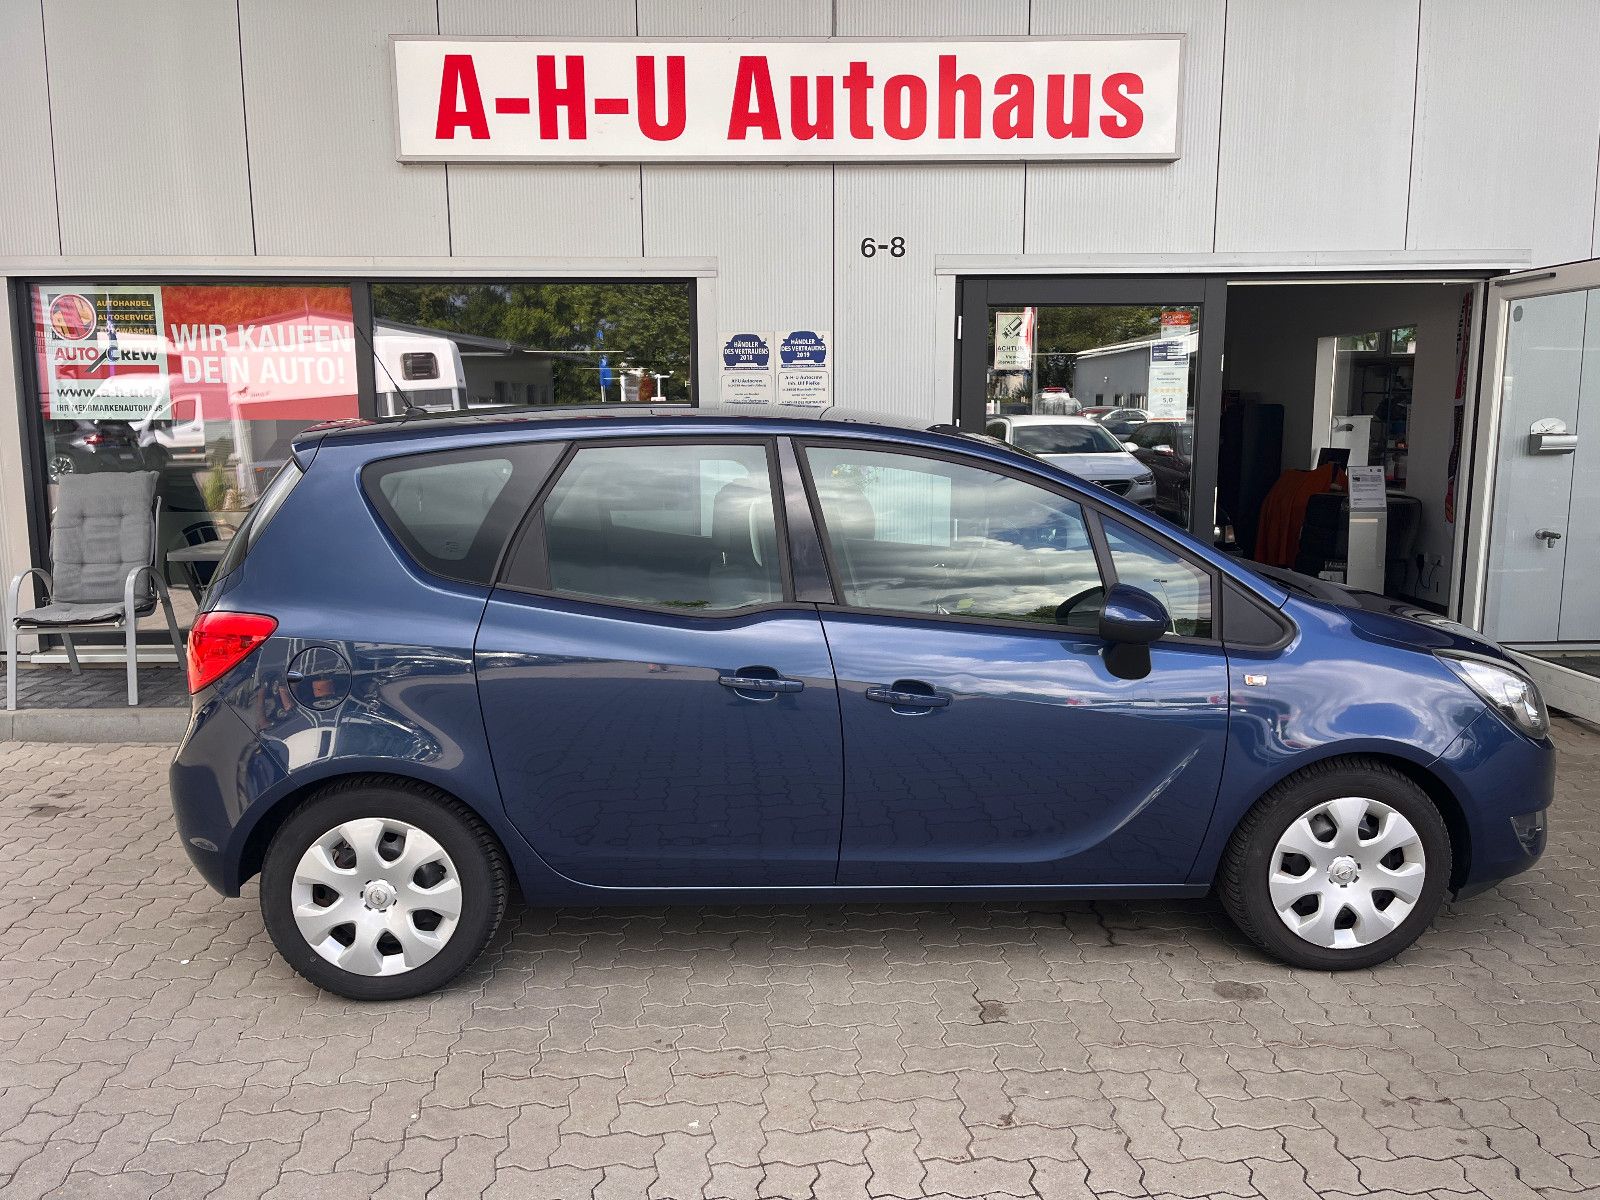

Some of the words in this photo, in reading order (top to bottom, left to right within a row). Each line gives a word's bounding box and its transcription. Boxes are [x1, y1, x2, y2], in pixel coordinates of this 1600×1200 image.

[435, 54, 686, 141] A-H-U
[728, 54, 1144, 140] Autohaus
[860, 236, 906, 258] 6-8
[170, 323, 228, 352] WIR
[238, 324, 351, 353] KAUFEN
[733, 340, 759, 348] HÄNDLER
[790, 337, 816, 345] HÄNDLER
[55, 347, 99, 361] AUTO
[107, 345, 158, 362] CREW
[735, 347, 769, 355] VERTRAUENS
[182, 355, 248, 385] DEIN
[258, 355, 346, 385] AUTO!
[57, 404, 69, 412] IHR
